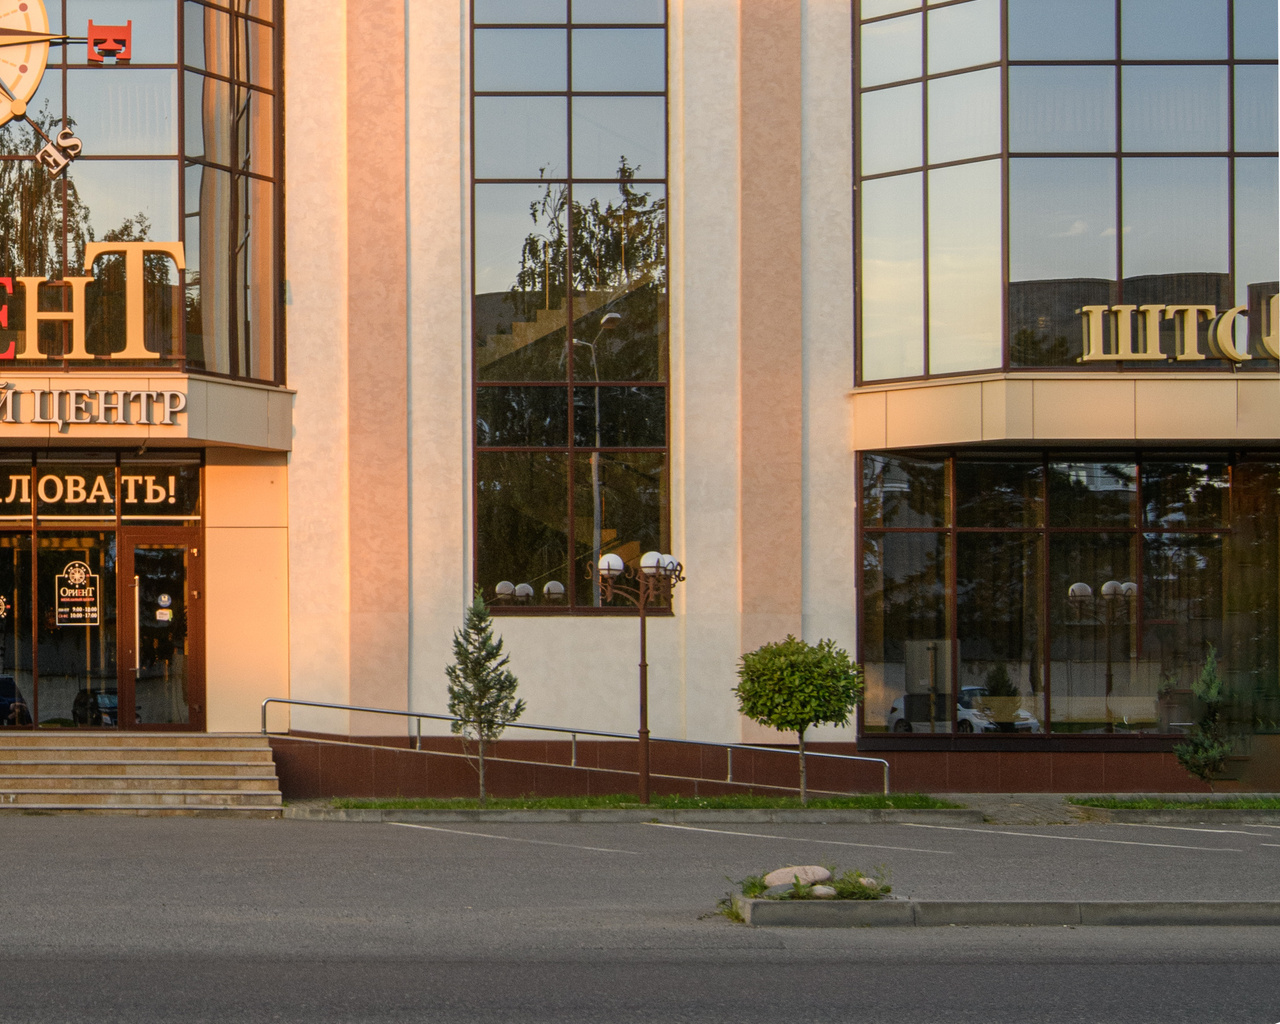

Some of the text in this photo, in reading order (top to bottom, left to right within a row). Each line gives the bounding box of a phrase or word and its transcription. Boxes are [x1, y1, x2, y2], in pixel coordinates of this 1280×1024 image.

[87, 19, 132, 61] E
[36, 127, 83, 178] SE
[31, 388, 187, 433] ЦЕНТР
[60, 587, 95, 597] ОРИЕНТ
